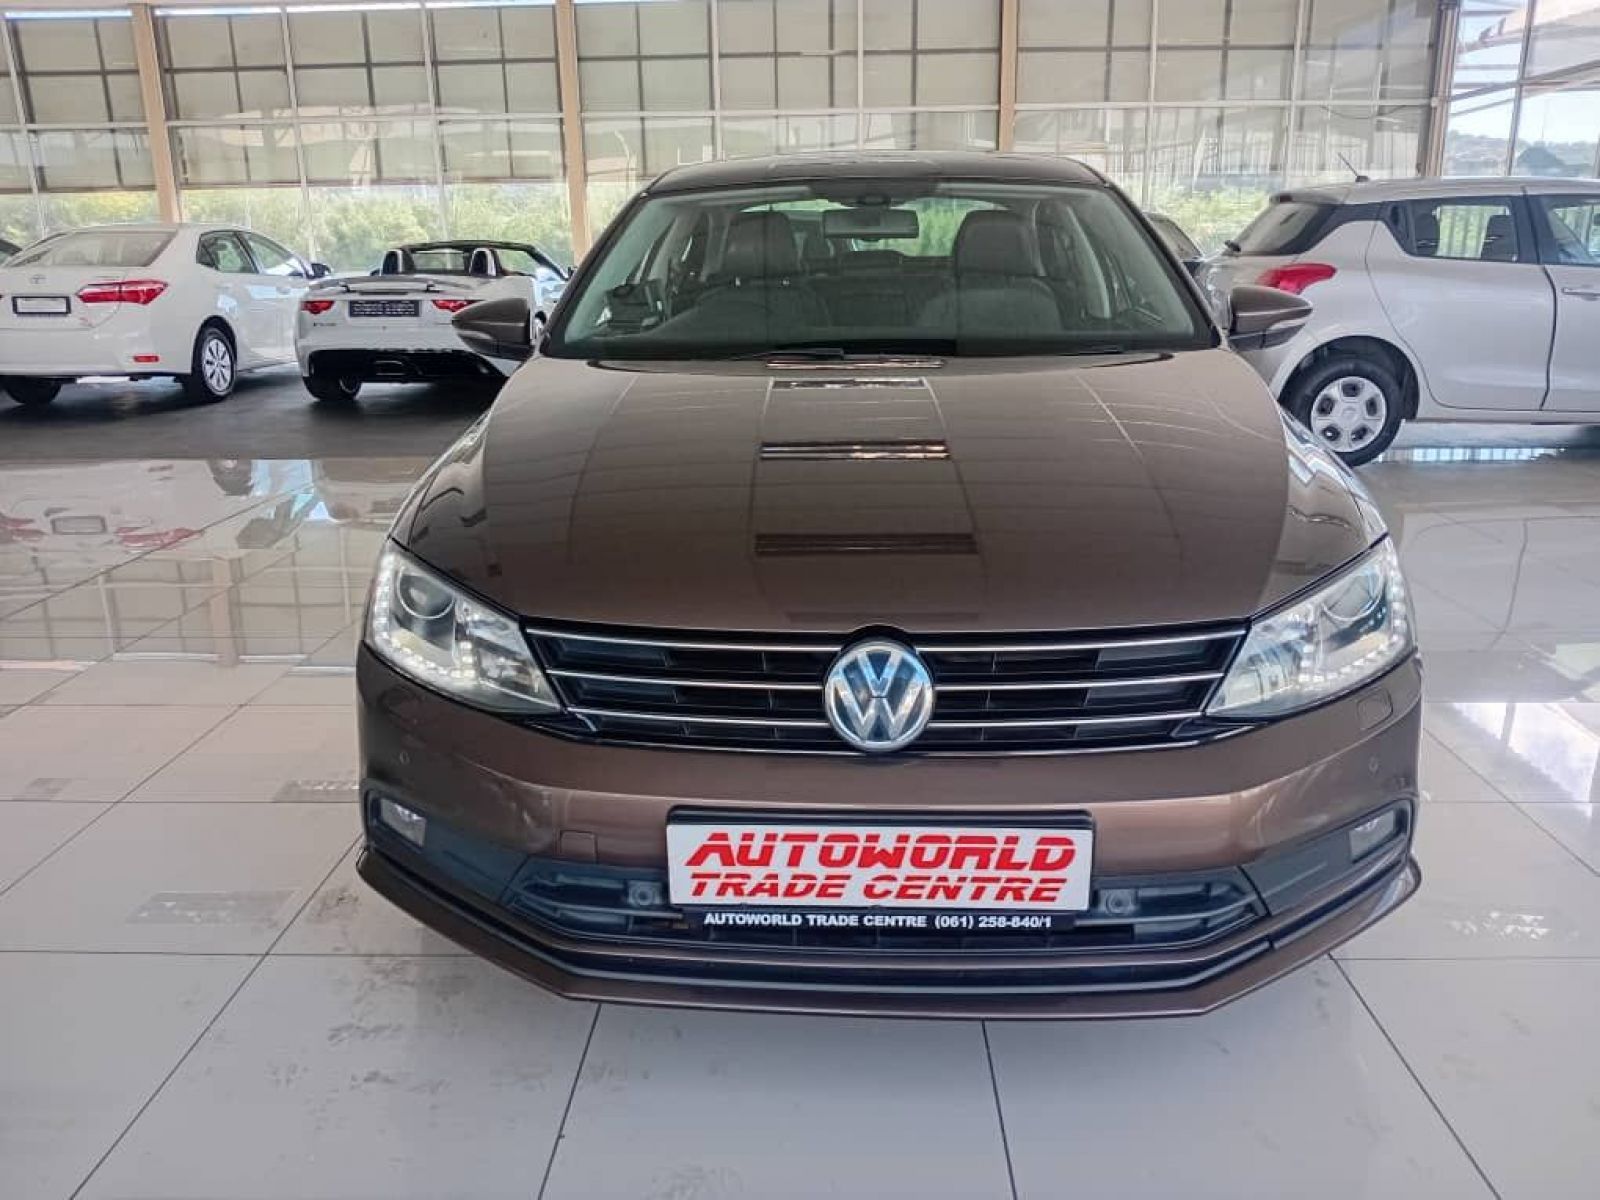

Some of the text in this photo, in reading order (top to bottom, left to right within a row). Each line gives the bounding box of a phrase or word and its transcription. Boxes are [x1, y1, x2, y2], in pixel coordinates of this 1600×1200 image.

[684, 832, 1076, 871] AUTOWORLD
[690, 872, 1068, 903] TRADE CENTRE
[704, 912, 802, 926] AUTOWORLD
[806, 914, 859, 927] TRADE
[863, 914, 928, 928] CENTRE
[934, 914, 974, 930] (061)
